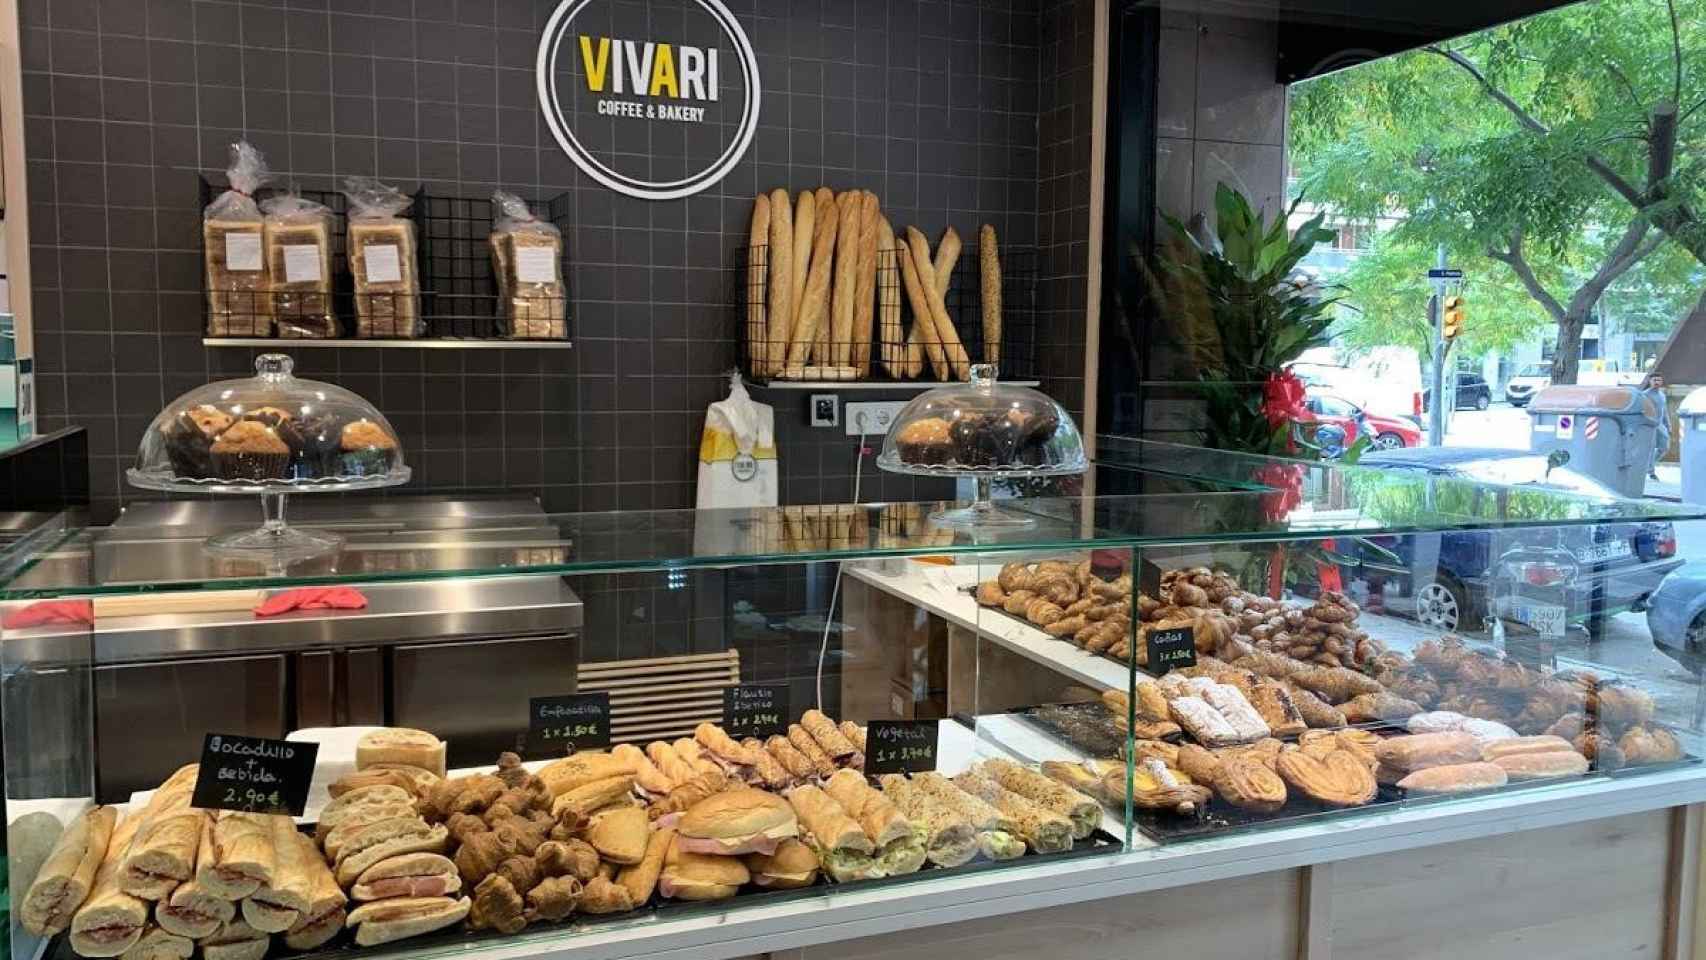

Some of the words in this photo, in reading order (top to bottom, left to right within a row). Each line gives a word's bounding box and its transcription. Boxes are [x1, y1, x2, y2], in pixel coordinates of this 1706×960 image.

[579, 35, 718, 101] VIVARI
[597, 99, 644, 118] COFFEE
[645, 103, 655, 119] &
[658, 105, 705, 122] BAKERY
[543, 727, 550, 739] 1
[876, 749, 886, 762] 1
[889, 750, 897, 760] x
